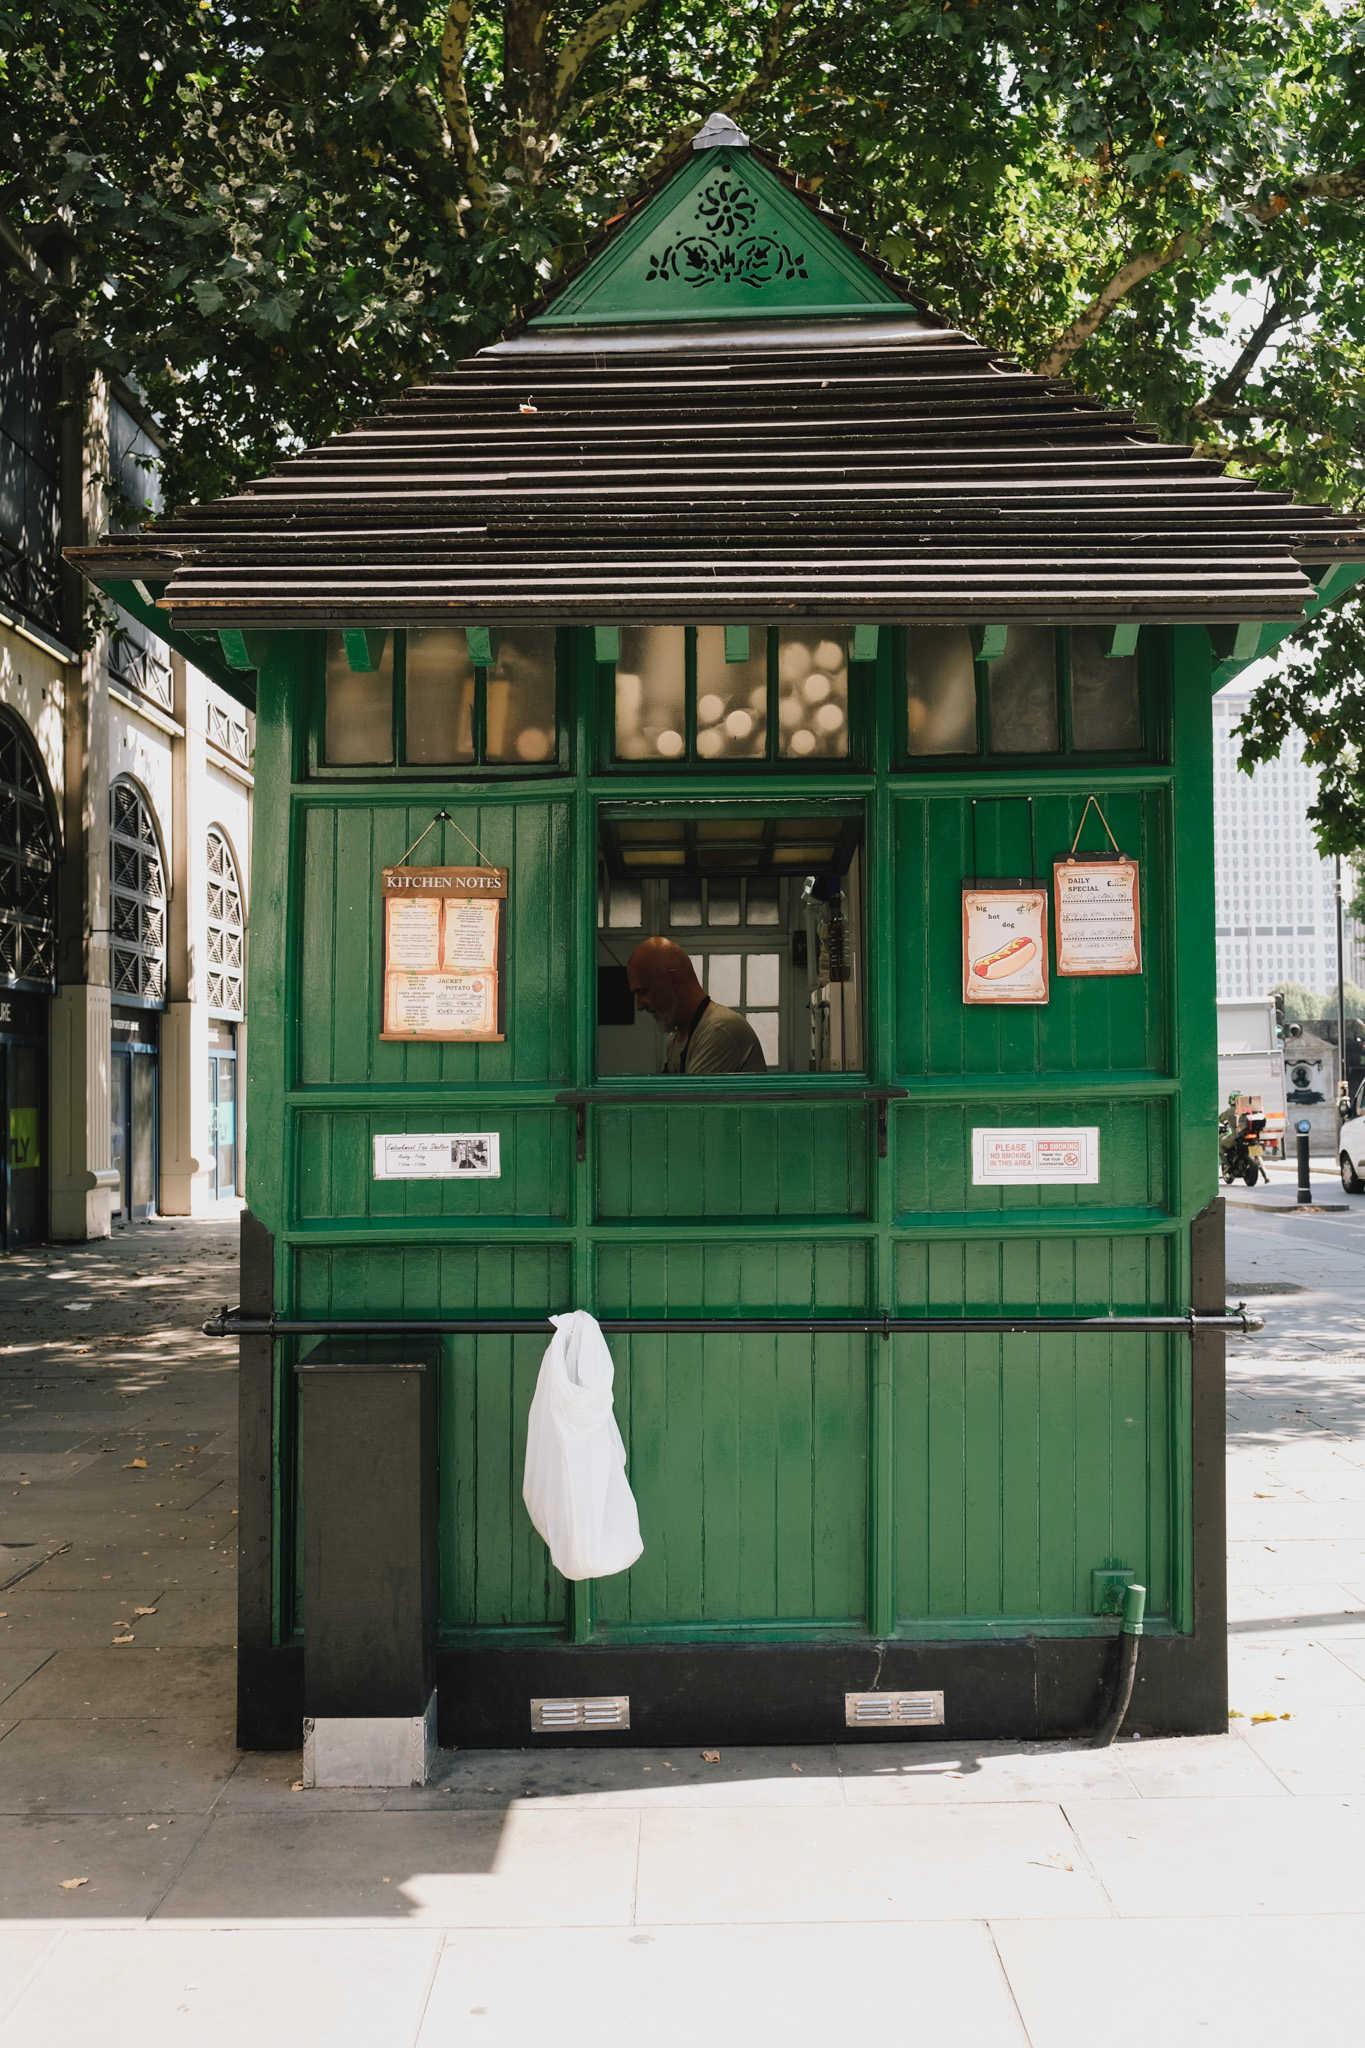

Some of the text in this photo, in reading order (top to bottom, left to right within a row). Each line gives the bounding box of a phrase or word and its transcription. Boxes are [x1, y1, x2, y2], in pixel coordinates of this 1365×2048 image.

[386, 876, 502, 888] KITCHEN NOTES
[995, 1143, 1027, 1151] PLEASE
